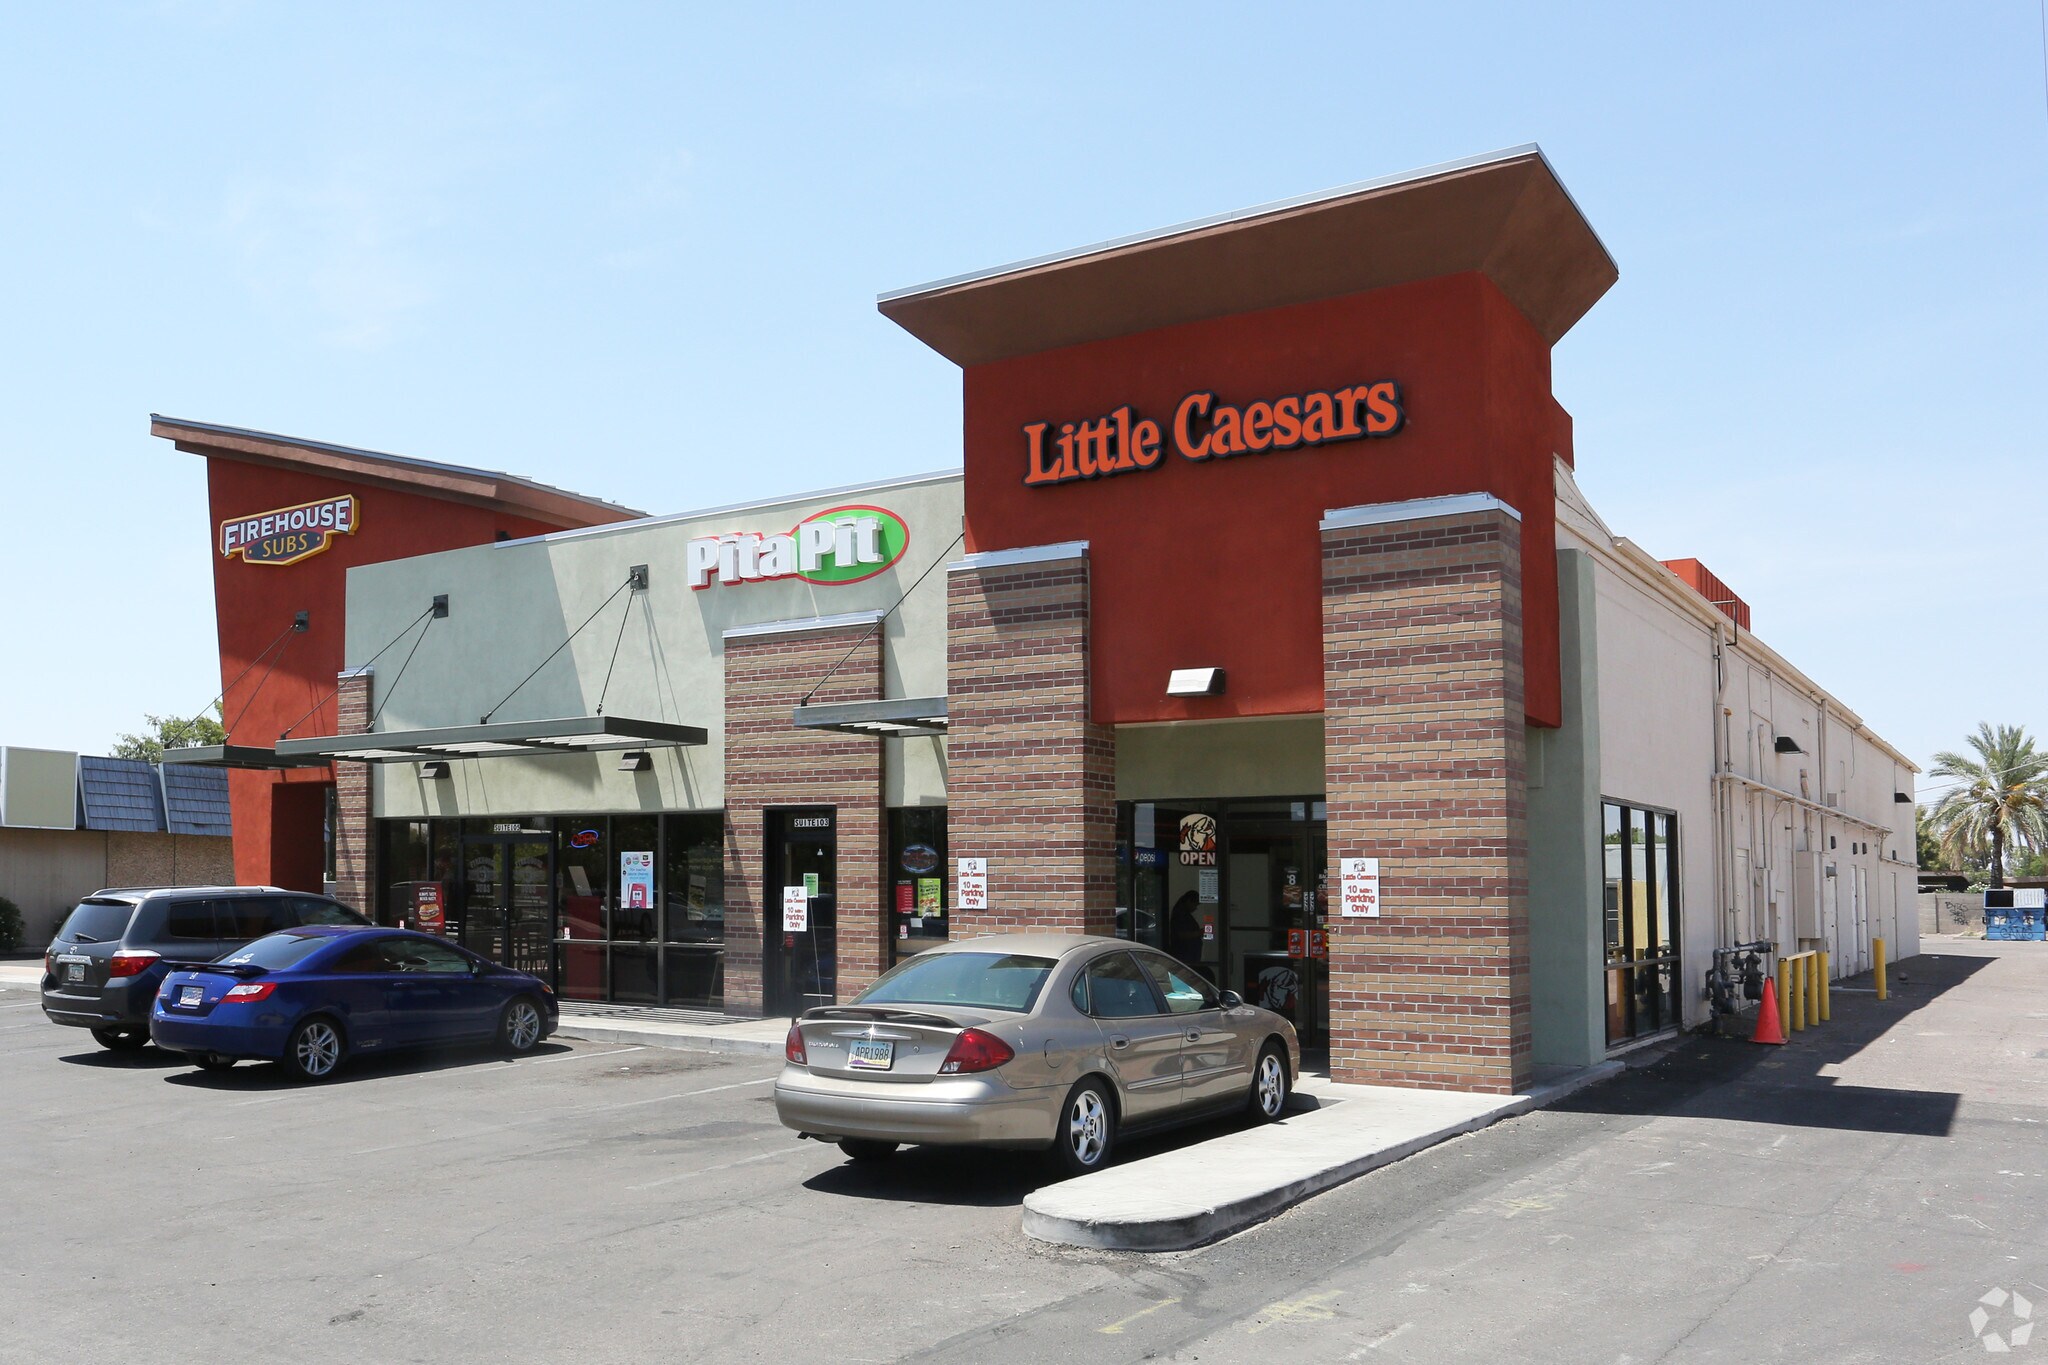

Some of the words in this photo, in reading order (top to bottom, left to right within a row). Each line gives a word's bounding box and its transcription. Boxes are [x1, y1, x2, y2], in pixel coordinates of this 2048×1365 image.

[1022, 404, 1164, 487] Little
[1172, 379, 1403, 461] Caesars
[223, 499, 351, 557] FIREHOUSE
[262, 532, 308, 558] SUBS
[687, 533, 798, 587] Pita
[799, 516, 885, 573] Pit
[1180, 851, 1217, 866] OPEN
[963, 881, 971, 889] 10
[1347, 884, 1358, 894] 10
[961, 889, 985, 898] Parking
[965, 897, 980, 906] Only
[1345, 894, 1376, 905] Parking
[1351, 904, 1370, 914] Only
[785, 914, 805, 922] Parking
[788, 921, 801, 930] Only
